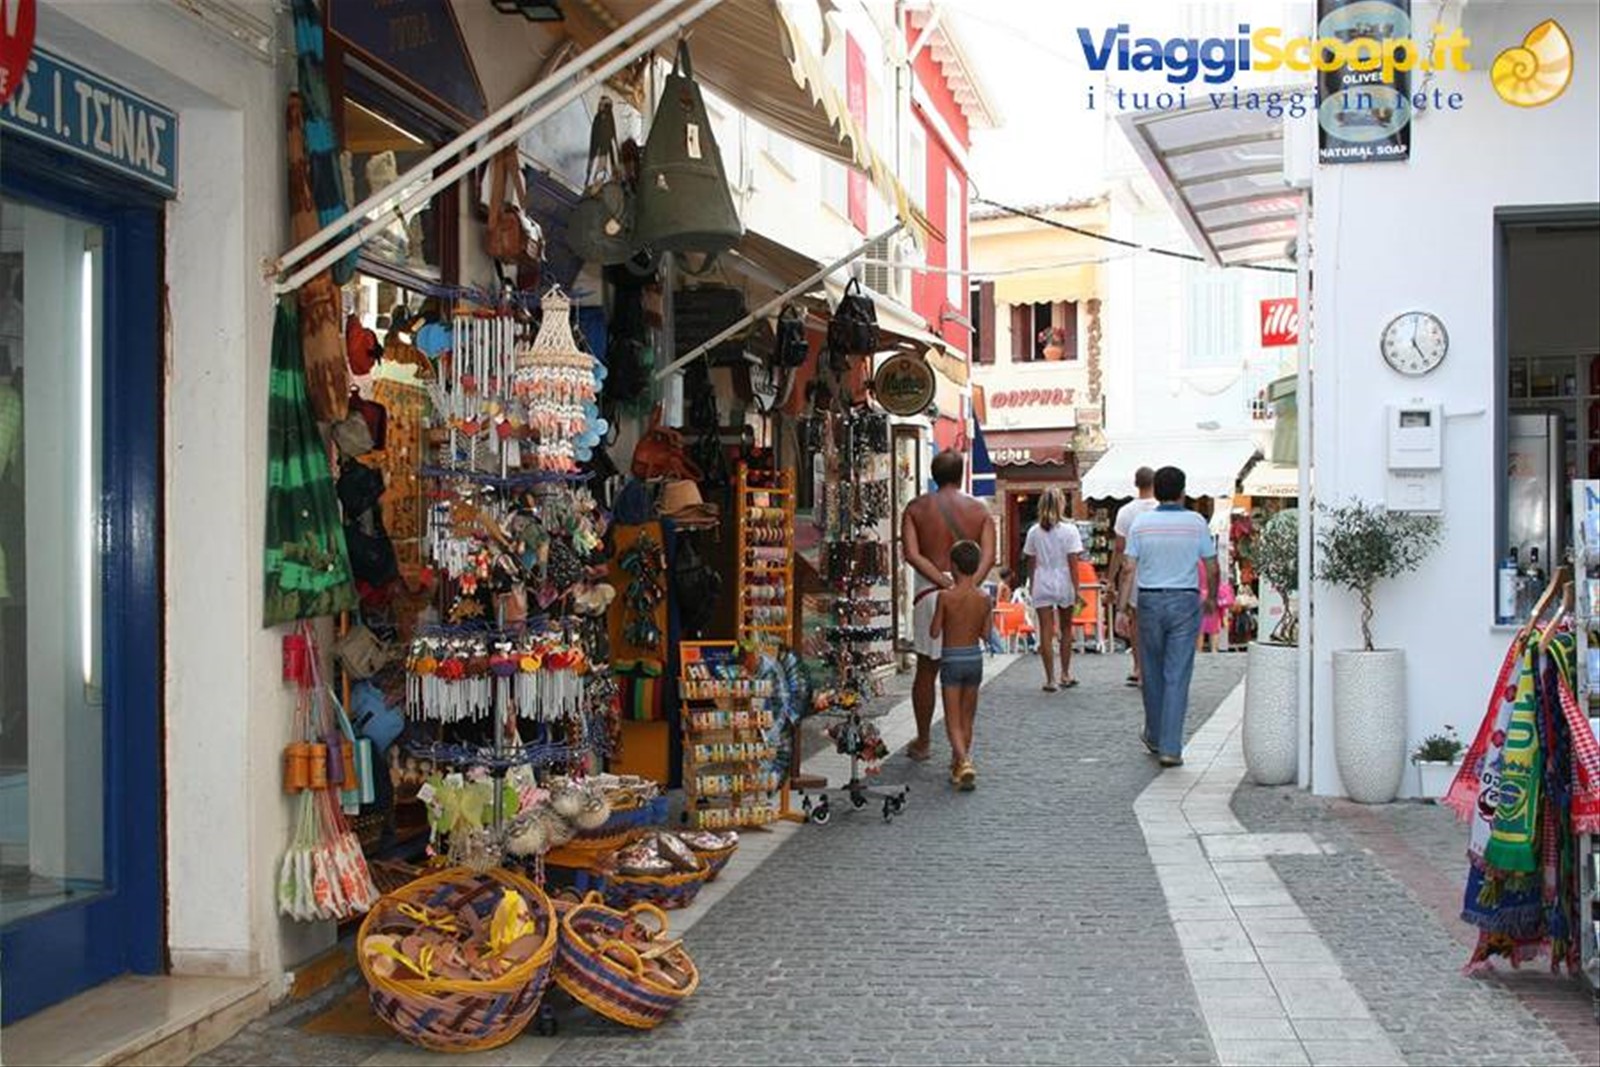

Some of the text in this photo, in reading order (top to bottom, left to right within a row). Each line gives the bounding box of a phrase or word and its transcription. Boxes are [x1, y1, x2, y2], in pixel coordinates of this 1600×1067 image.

[74, 79, 167, 177] ΤΣΙΝΑΣ
[1320, 144, 1408, 159] NATURAL SOAP
